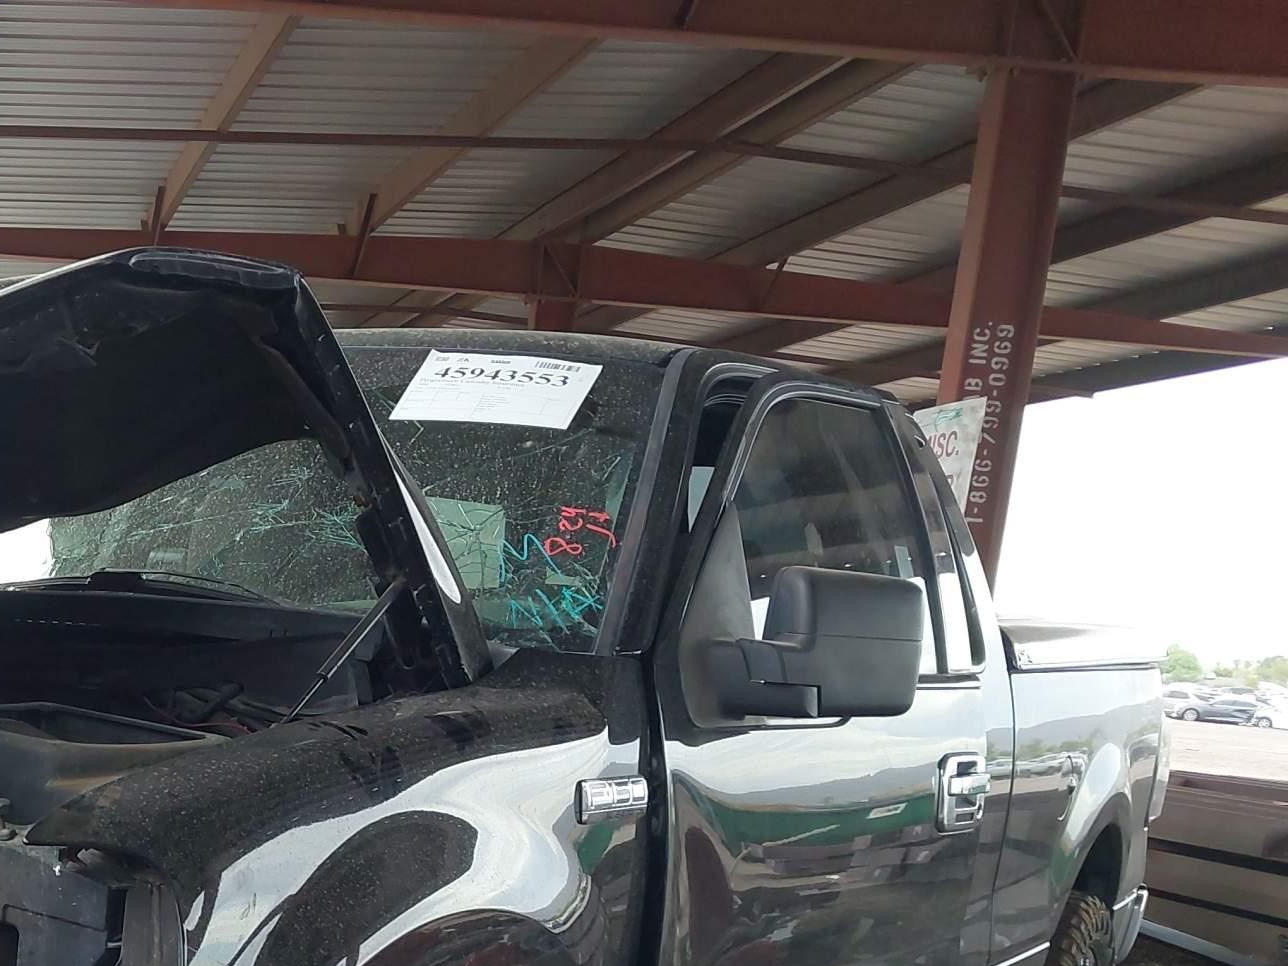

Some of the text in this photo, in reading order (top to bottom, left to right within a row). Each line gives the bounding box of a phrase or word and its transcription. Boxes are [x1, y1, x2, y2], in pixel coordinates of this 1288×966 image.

[968, 321, 993, 365] INC.
[434, 366, 570, 388] 45943553
[964, 324, 1015, 524] 1-866-799-0969
